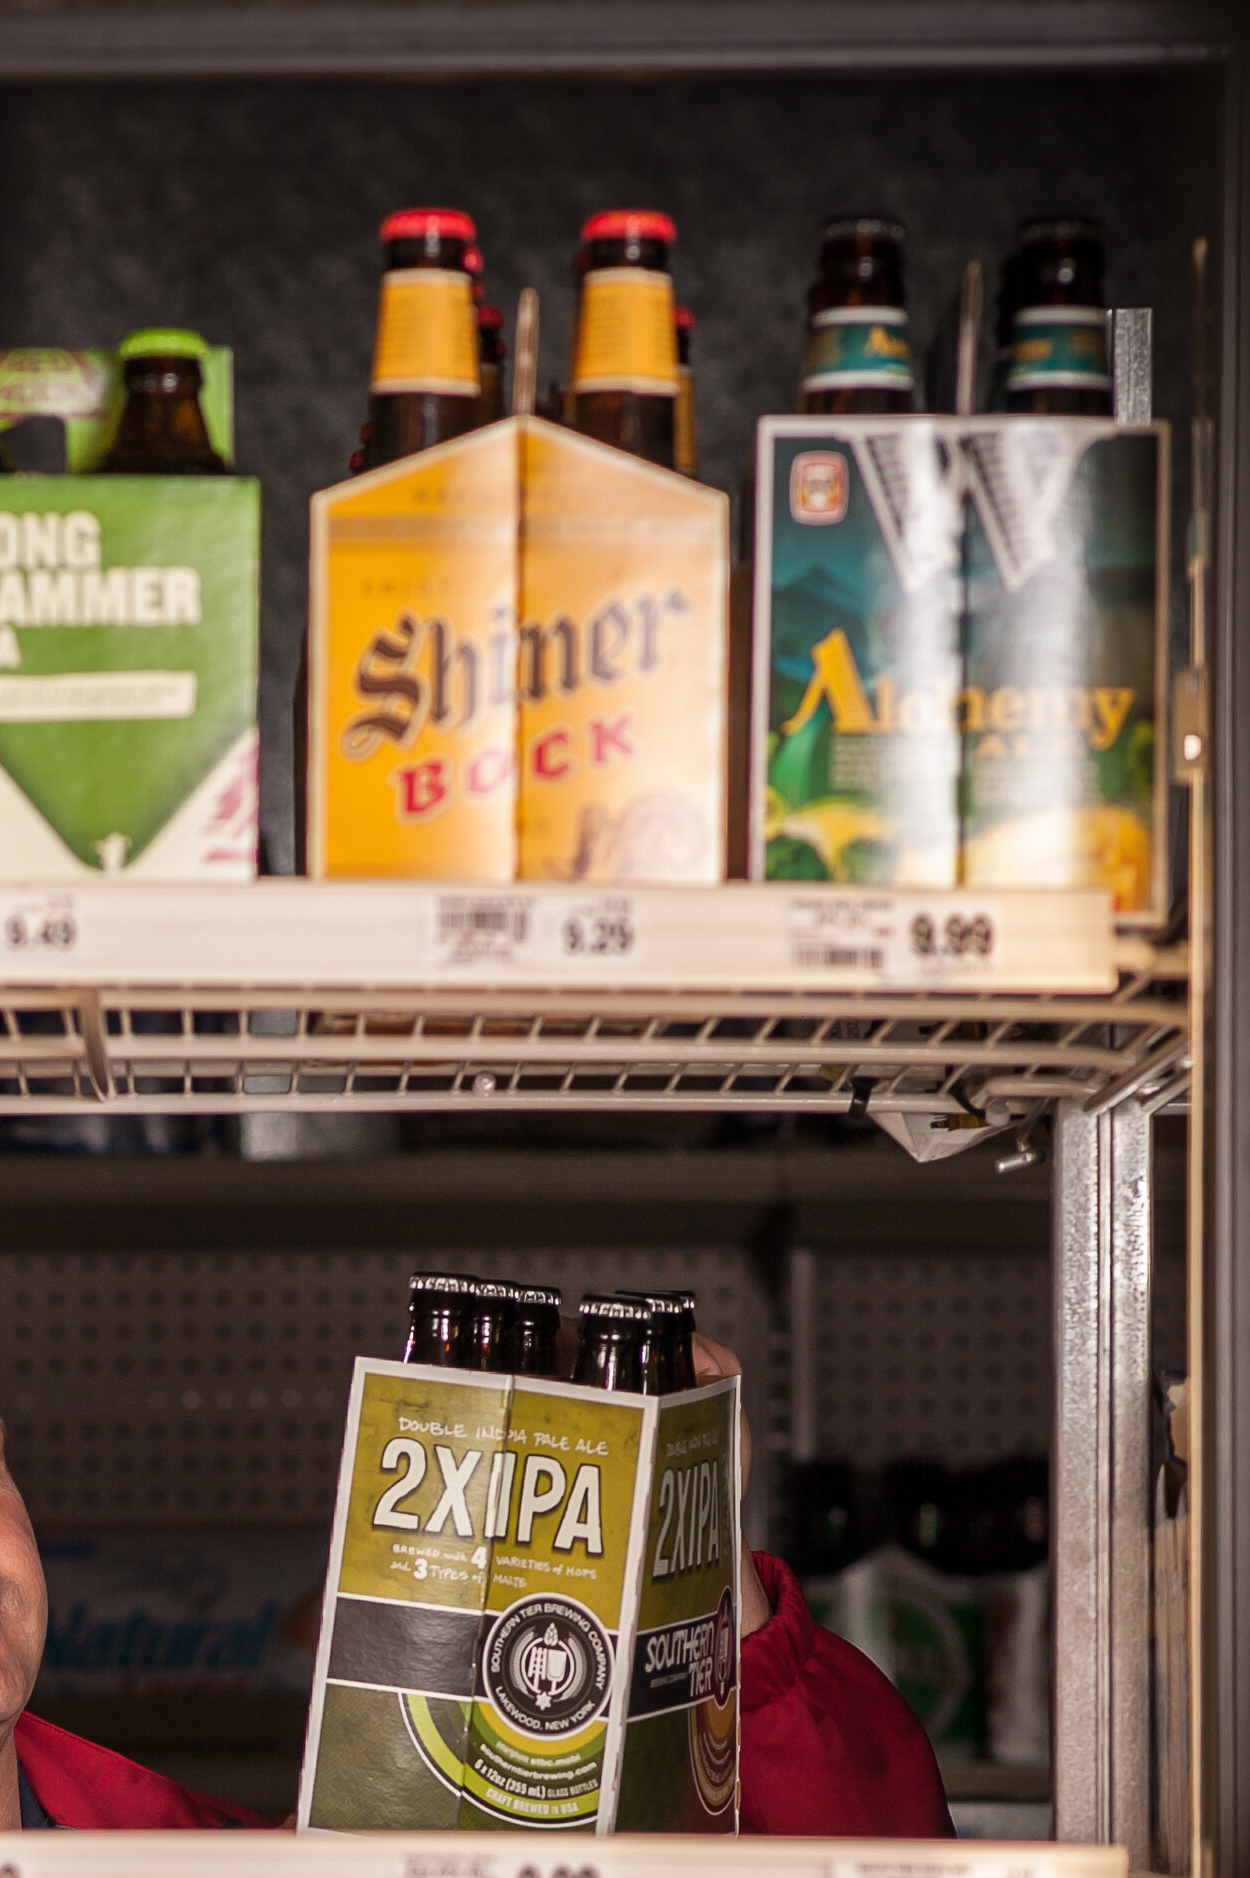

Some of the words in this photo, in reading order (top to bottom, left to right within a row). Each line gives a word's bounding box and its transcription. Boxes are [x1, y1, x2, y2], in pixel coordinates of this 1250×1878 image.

[341, 590, 690, 757] Shiner
[398, 712, 636, 819] BOCK
[398, 1417, 469, 1439] DOUBLE
[533, 1432, 570, 1450] PALE
[575, 1440, 609, 1456] ALE
[392, 1544, 441, 1560] BREWED
[470, 1546, 488, 1569] 4
[496, 1556, 551, 1573] VARIETIES
[552, 1564, 563, 1577] of
[565, 1567, 598, 1580] HOPS
[413, 1558, 429, 1580] 3
[430, 1564, 469, 1581] TYPES
[471, 1572, 484, 1584] of
[493, 1573, 527, 1588] MALTS
[491, 1614, 520, 1673] SOUTHERN
[520, 1603, 543, 1619] TIER
[544, 1603, 591, 1632] BREWING
[588, 1631, 607, 1691] COMPANY
[645, 1620, 715, 1673] SOUTHERN
[688, 1656, 713, 1697] TIER
[544, 1718, 570, 1731] NEW
[570, 1700, 596, 1724] YORK
